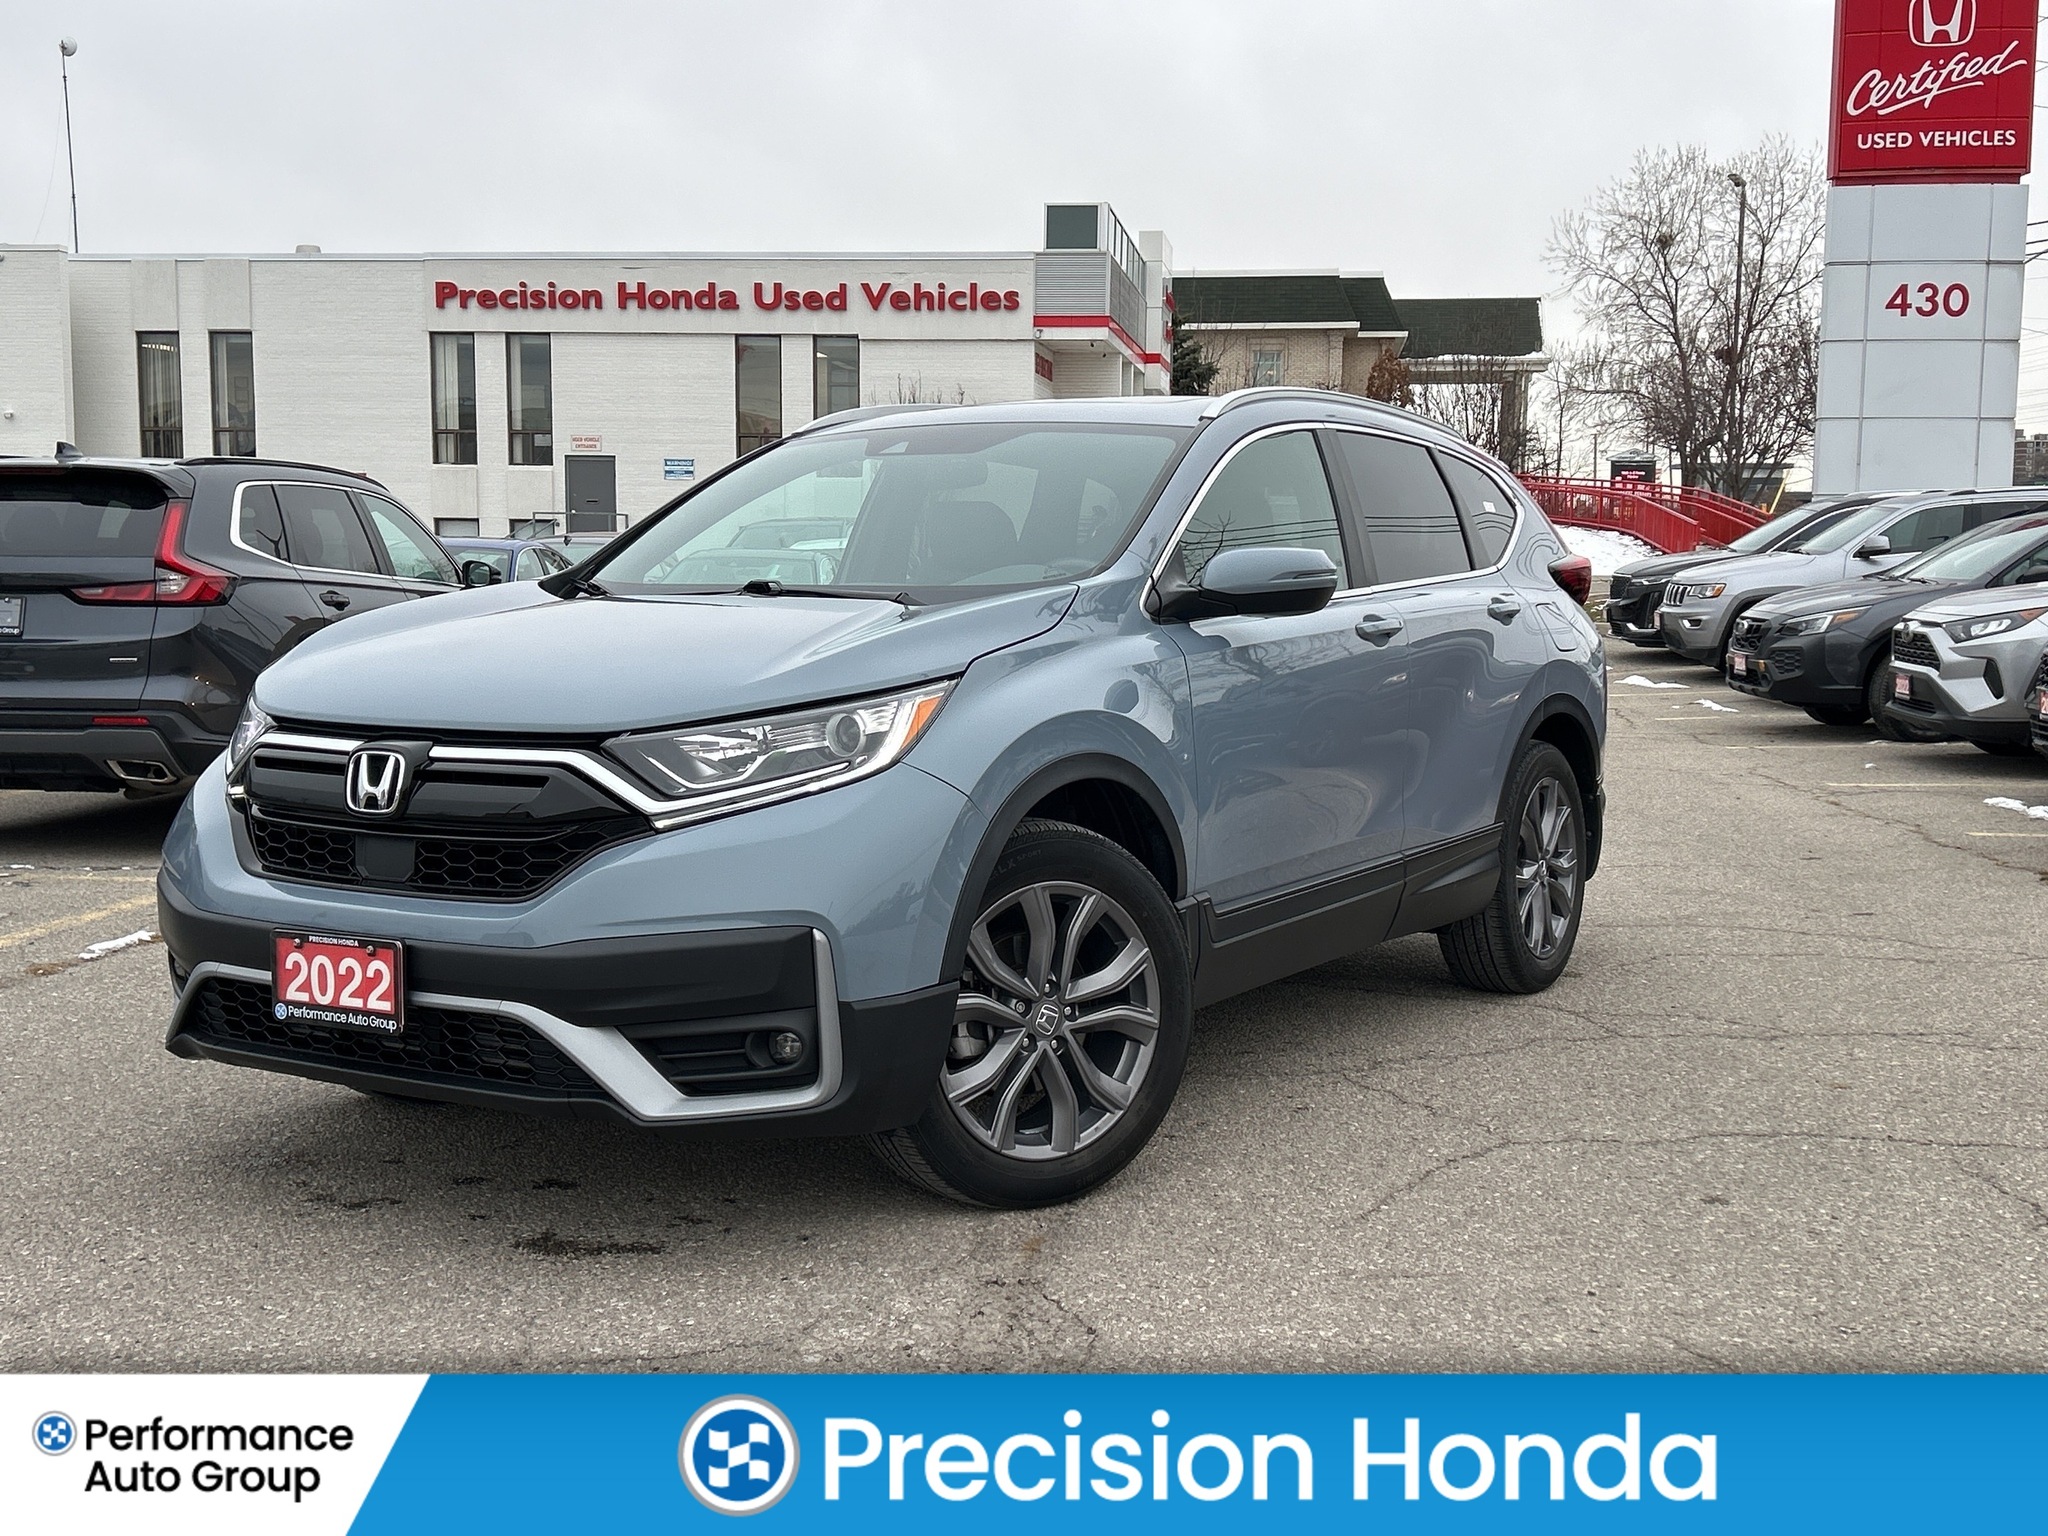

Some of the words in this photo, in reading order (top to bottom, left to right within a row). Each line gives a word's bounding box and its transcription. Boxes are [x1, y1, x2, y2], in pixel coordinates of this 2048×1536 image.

[1846, 40, 2028, 116] Certified
[1857, 132, 1913, 149] USED
[1919, 130, 2016, 147] VEHICLES
[434, 280, 603, 309] Precision
[616, 281, 739, 310] Honda
[753, 282, 847, 311] Used
[861, 282, 1020, 311] Vehicles
[1885, 282, 1970, 318] 430
[308, 935, 338, 945] PRECISION
[338, 939, 360, 947] HONDA
[285, 951, 392, 1011] 2022
[288, 1005, 347, 1023] Performance
[347, 1013, 369, 1026] Auto
[369, 1016, 397, 1034] Group
